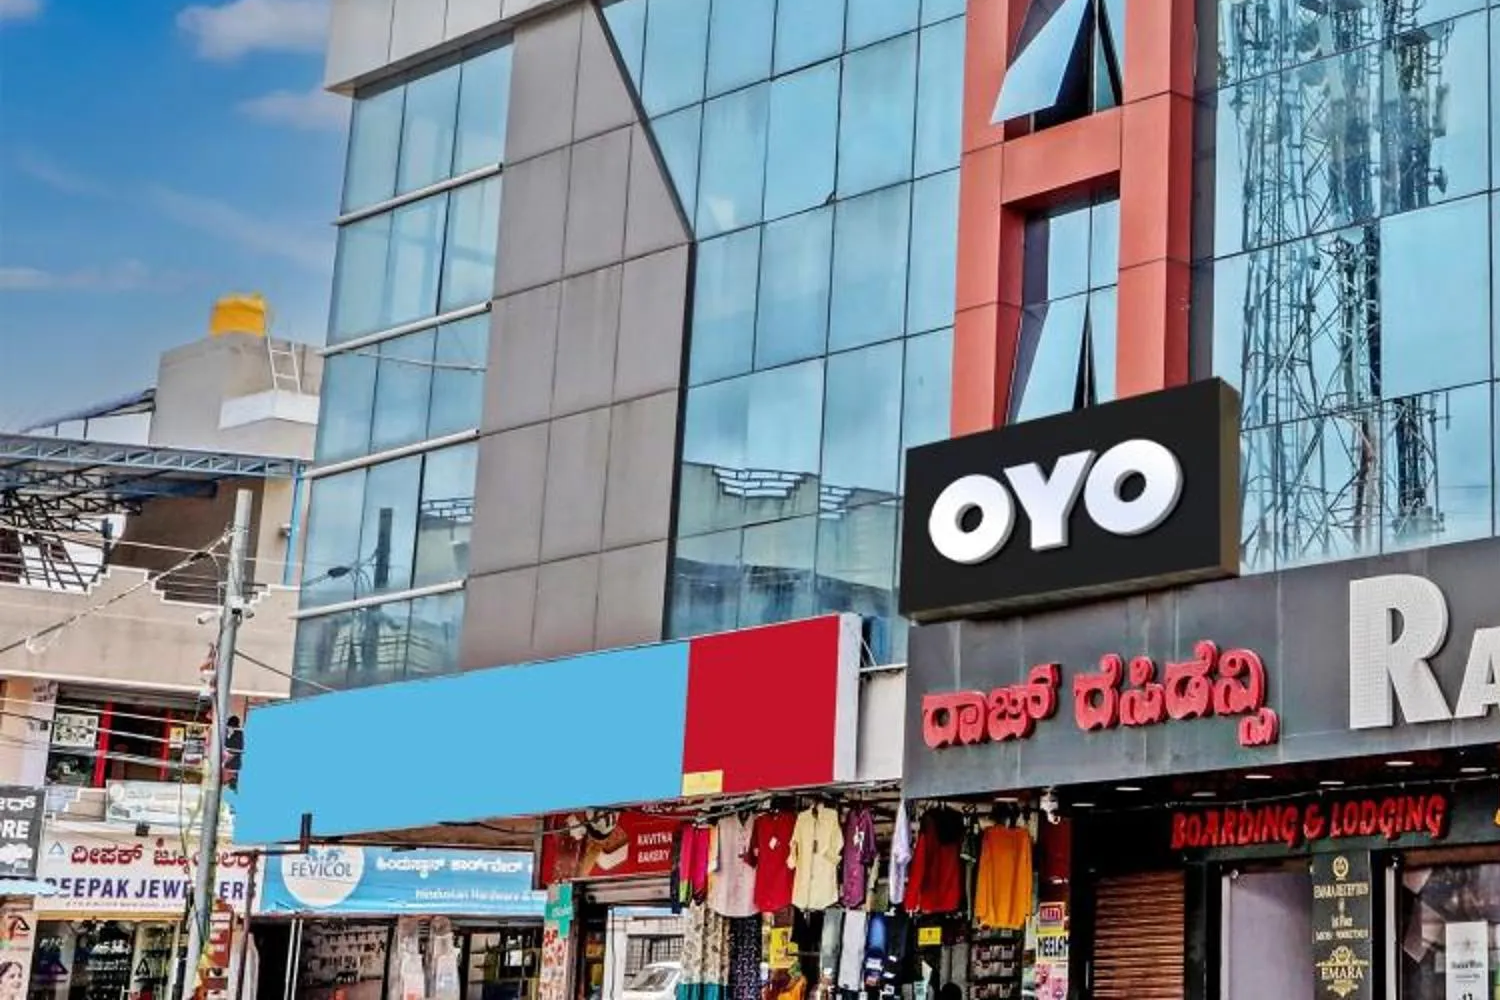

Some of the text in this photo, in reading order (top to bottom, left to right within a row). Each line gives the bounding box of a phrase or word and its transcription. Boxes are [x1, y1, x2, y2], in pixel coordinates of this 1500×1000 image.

[928, 439, 1184, 565] OYO
[922, 663, 1062, 749] ರಾಜ್
[0, 819, 31, 838] RE
[1170, 794, 1446, 849] BOARDING & LODGING
[290, 860, 352, 877] FEVICOL
